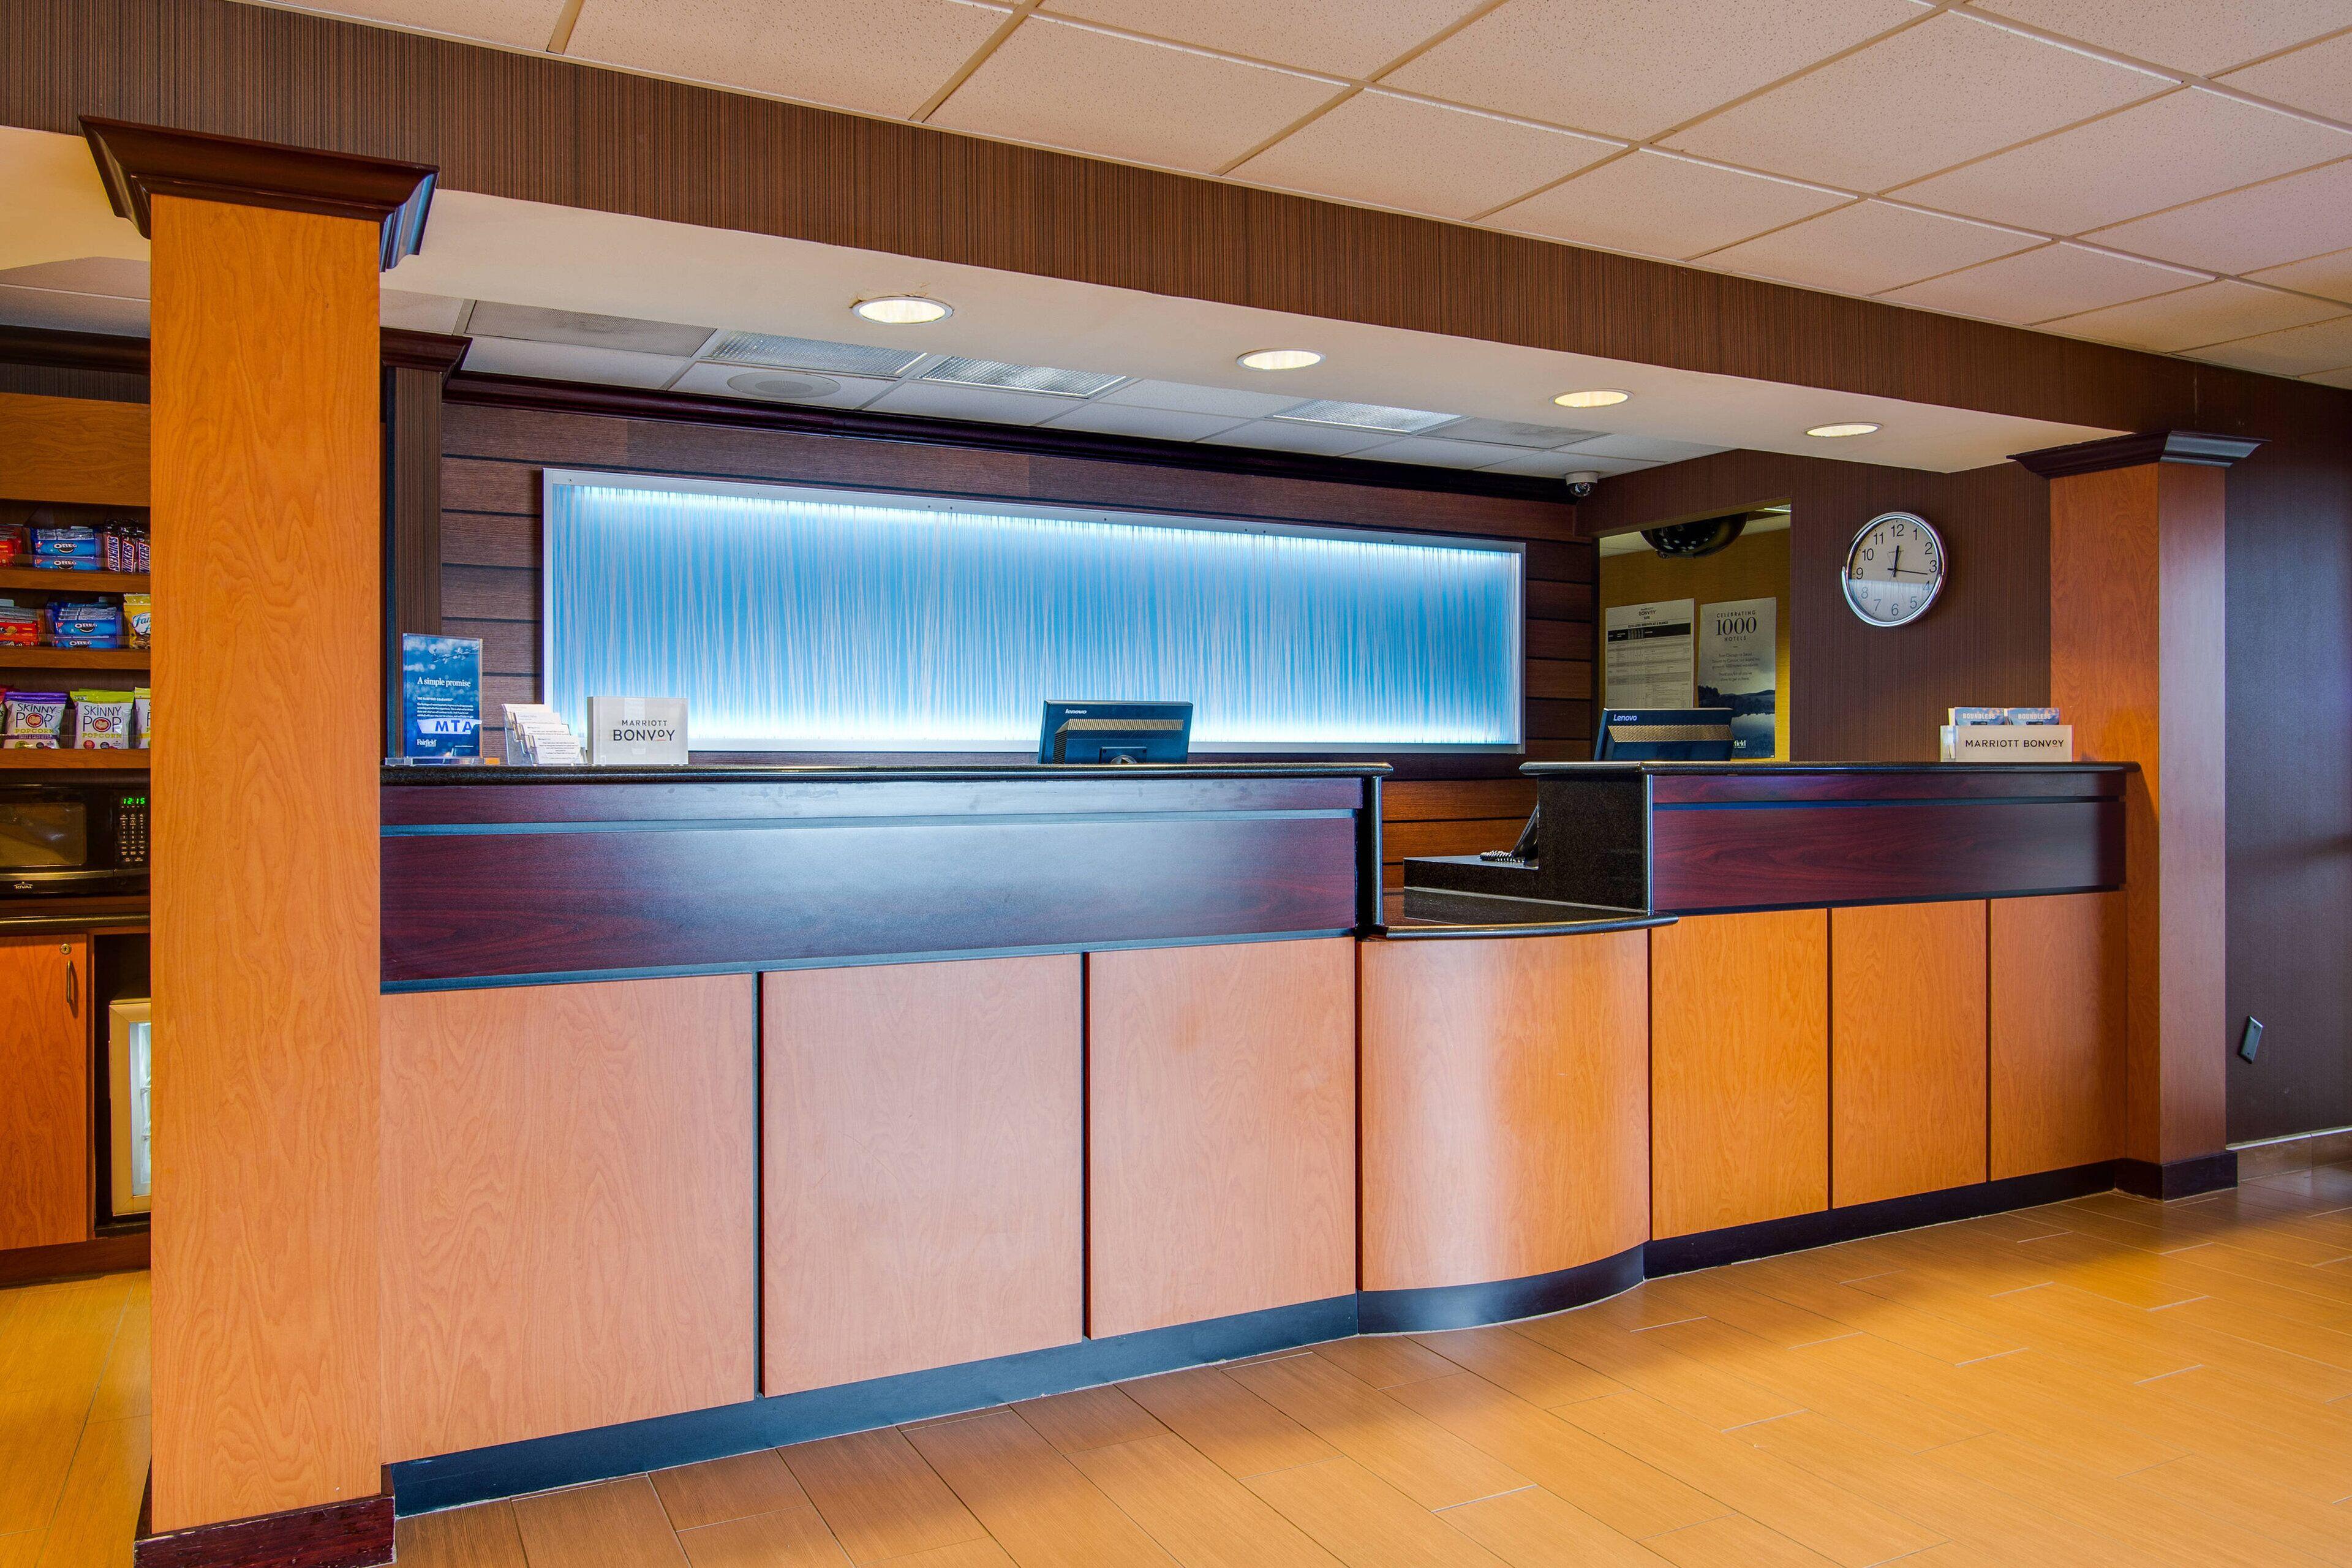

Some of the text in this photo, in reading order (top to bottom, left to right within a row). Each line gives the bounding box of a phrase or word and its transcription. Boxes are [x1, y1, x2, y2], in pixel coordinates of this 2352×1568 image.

[1891, 524, 1904, 537] 12
[1913, 528, 1918, 540] 1
[1874, 532, 1883, 545] 11
[108, 537, 119, 571] SNICKERS
[1862, 548, 1874, 561] 10
[1924, 542, 1932, 555] 2
[123, 543, 133, 573] NICKERS
[139, 544, 150, 573] NICKERS
[1856, 567, 1863, 579] 9
[1929, 560, 1937, 573] 3
[1861, 587, 1869, 598] 8
[1923, 581, 1931, 592] 4
[1874, 598, 1882, 611] 7
[1910, 596, 1918, 609] 5
[1891, 603, 1899, 616] 6
[1716, 616, 1757, 636] 1000
[424, 678, 445, 687] simple
[17, 703, 56, 713] SKINNY
[83, 705, 122, 716] SKINNY
[16, 712, 53, 728] POP
[83, 715, 122, 733] POP
[435, 720, 472, 732] MTA
[613, 729, 675, 741] BONVOY
